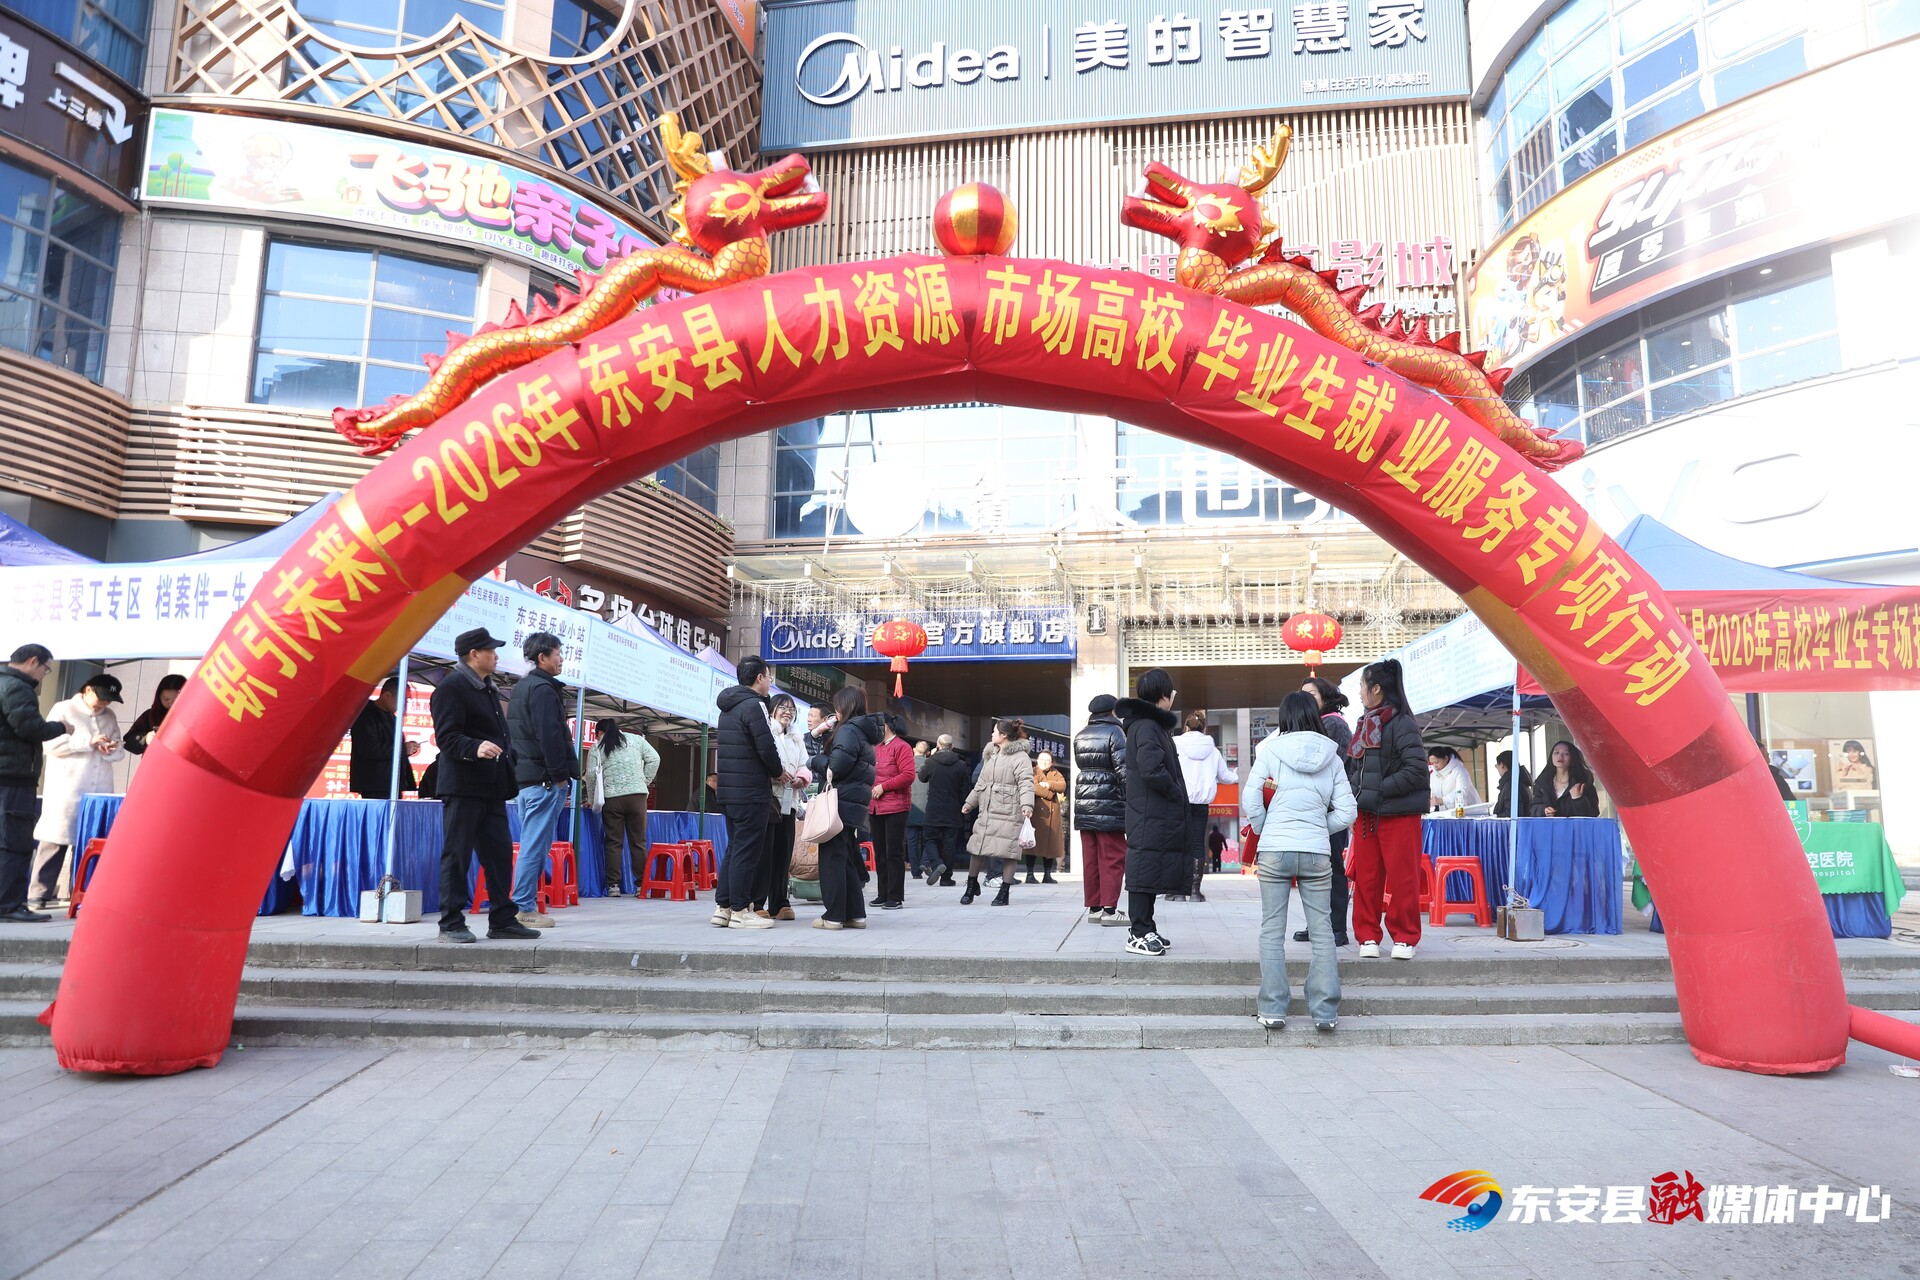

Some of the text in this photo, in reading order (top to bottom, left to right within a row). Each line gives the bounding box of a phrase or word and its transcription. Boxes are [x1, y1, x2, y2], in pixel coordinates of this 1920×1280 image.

[1073, 0, 1428, 74] 美的智慧家
[797, 32, 1020, 104] Midea
[349, 150, 652, 270] 飞驰亲子
[483, 230, 535, 254] DIY手工区
[11, 574, 142, 623] 东安县零工专区
[515, 605, 586, 643] 东安县乐业小站
[771, 622, 856, 653] Midea
[1676, 603, 1920, 673] 县2026年高校毕业生专场
